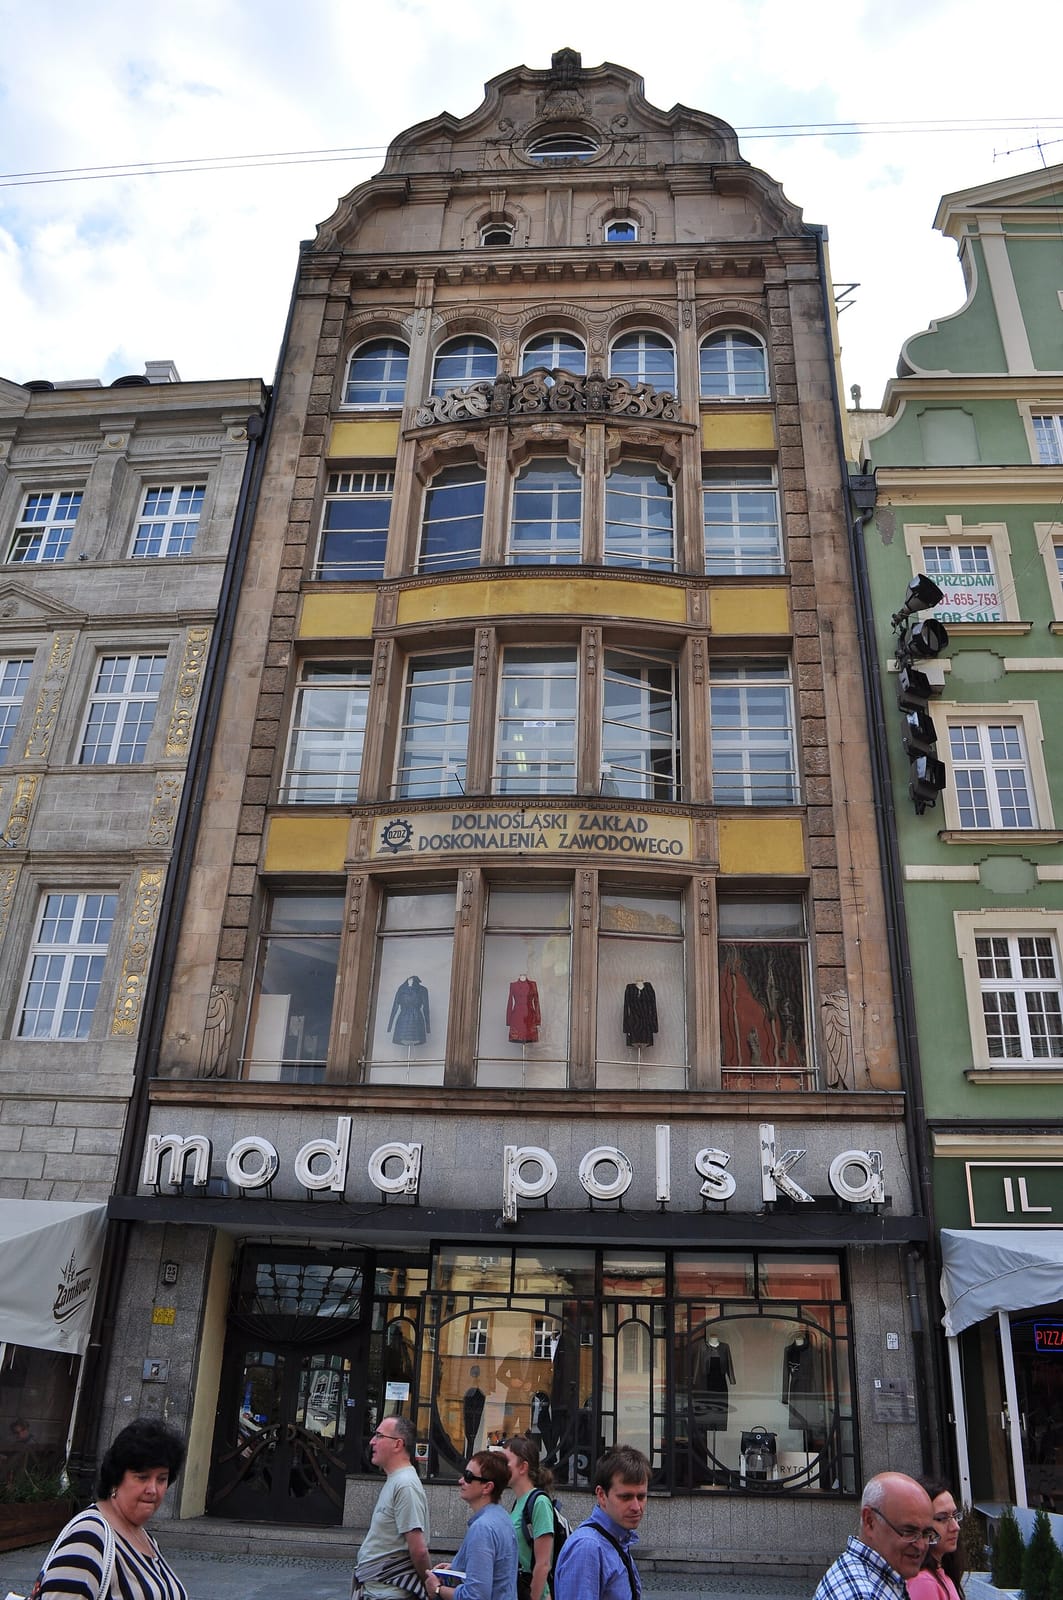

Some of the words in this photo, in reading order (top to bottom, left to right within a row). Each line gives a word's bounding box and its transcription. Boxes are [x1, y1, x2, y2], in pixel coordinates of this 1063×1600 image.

[928, 574, 995, 587] SPRZEDAM
[933, 612, 963, 622] FOR
[966, 612, 1000, 622] SALE
[452, 812, 568, 833] DOLNOŚLĄSKI
[579, 814, 649, 833] ZAKŁAD
[418, 832, 549, 851] DOSKONALENIA
[558, 832, 684, 856] ZAWODOWEGO
[143, 1116, 423, 1195] moda
[502, 1123, 885, 1224] polska
[1003, 1177, 1053, 1212] IL
